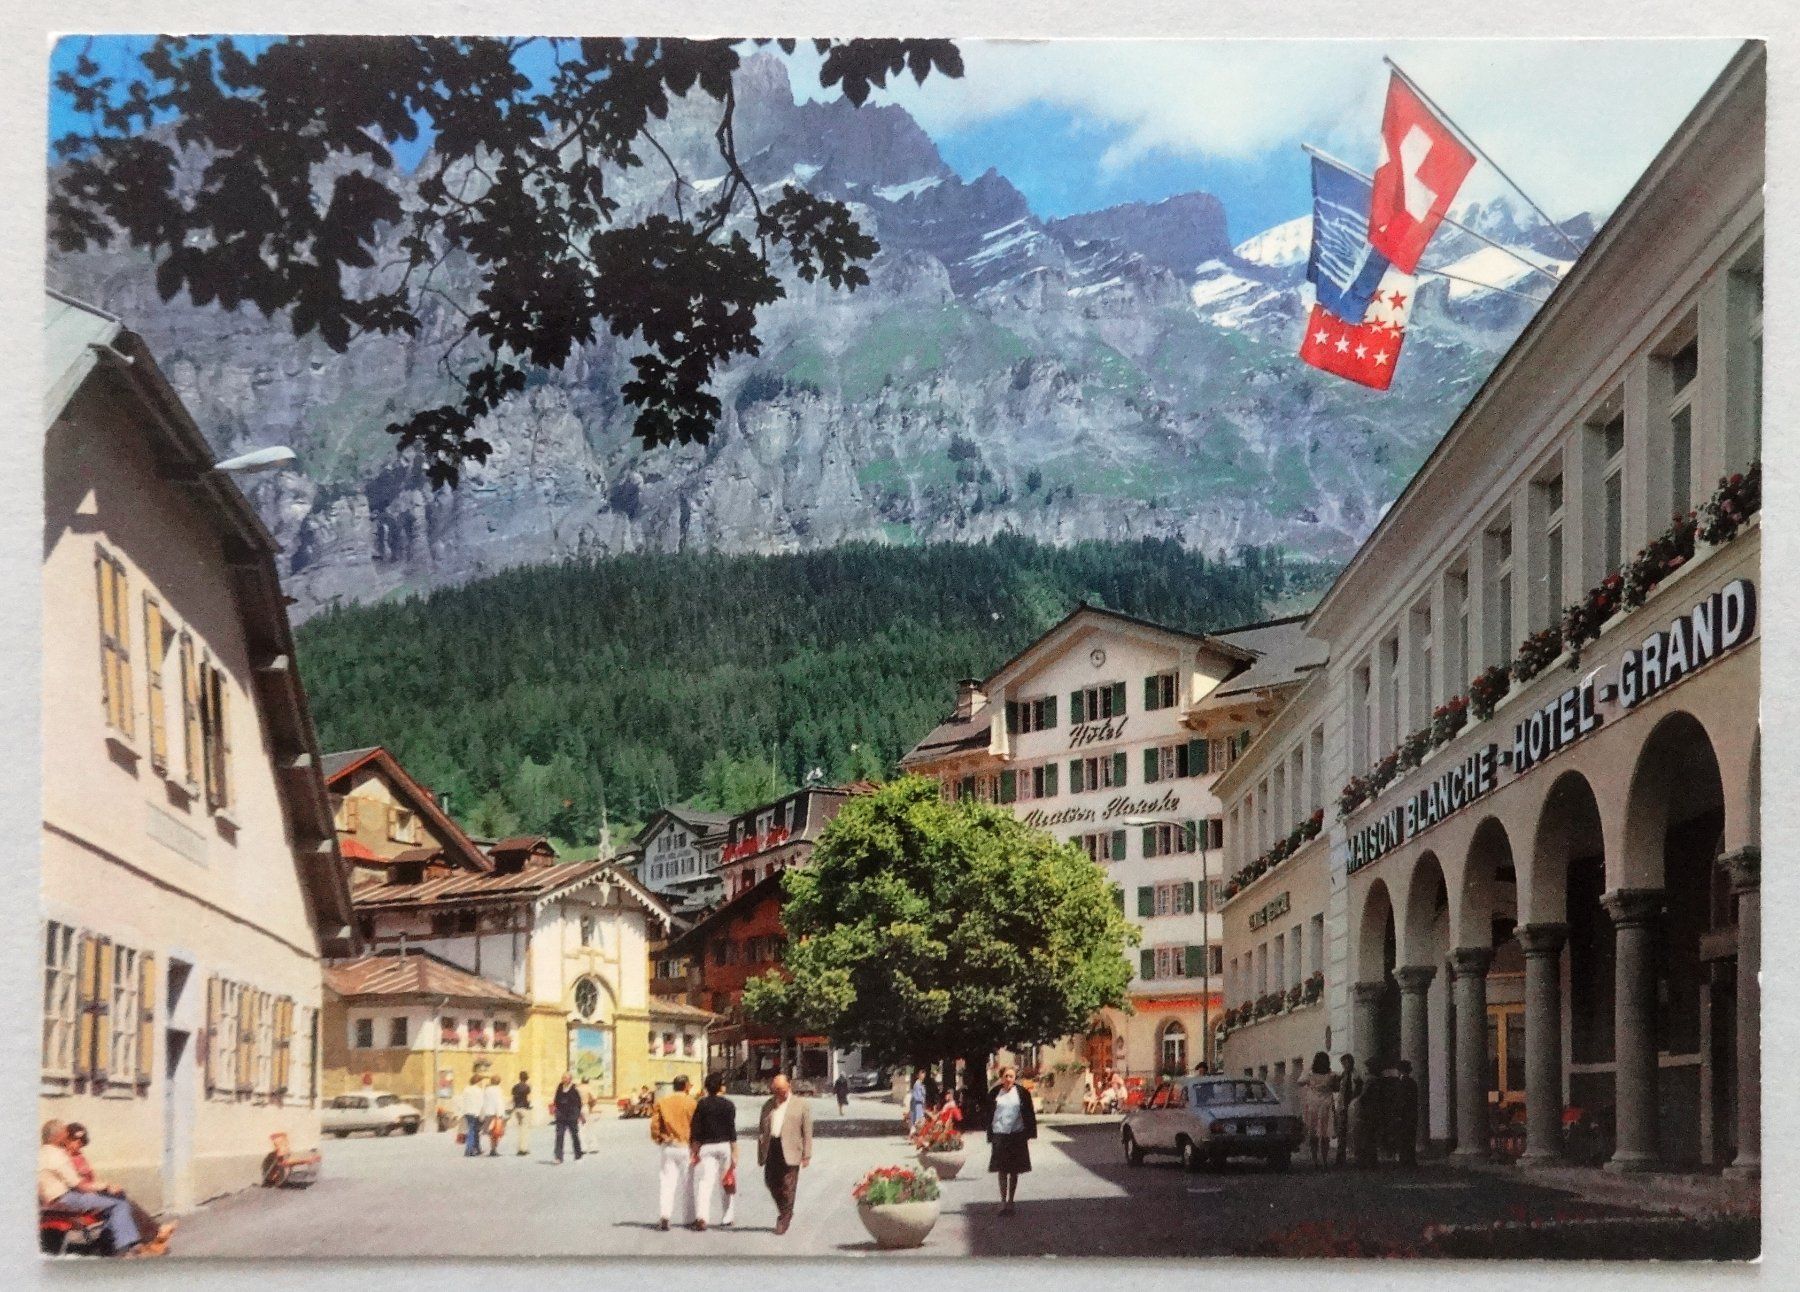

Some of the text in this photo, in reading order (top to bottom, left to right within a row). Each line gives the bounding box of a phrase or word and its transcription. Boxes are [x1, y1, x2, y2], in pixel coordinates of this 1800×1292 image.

[1347, 806, 1402, 875] MAISON
[1406, 743, 1498, 837] BLANCHE
[1513, 680, 1602, 773] HOTEL
[1617, 578, 1757, 709] GRAND
